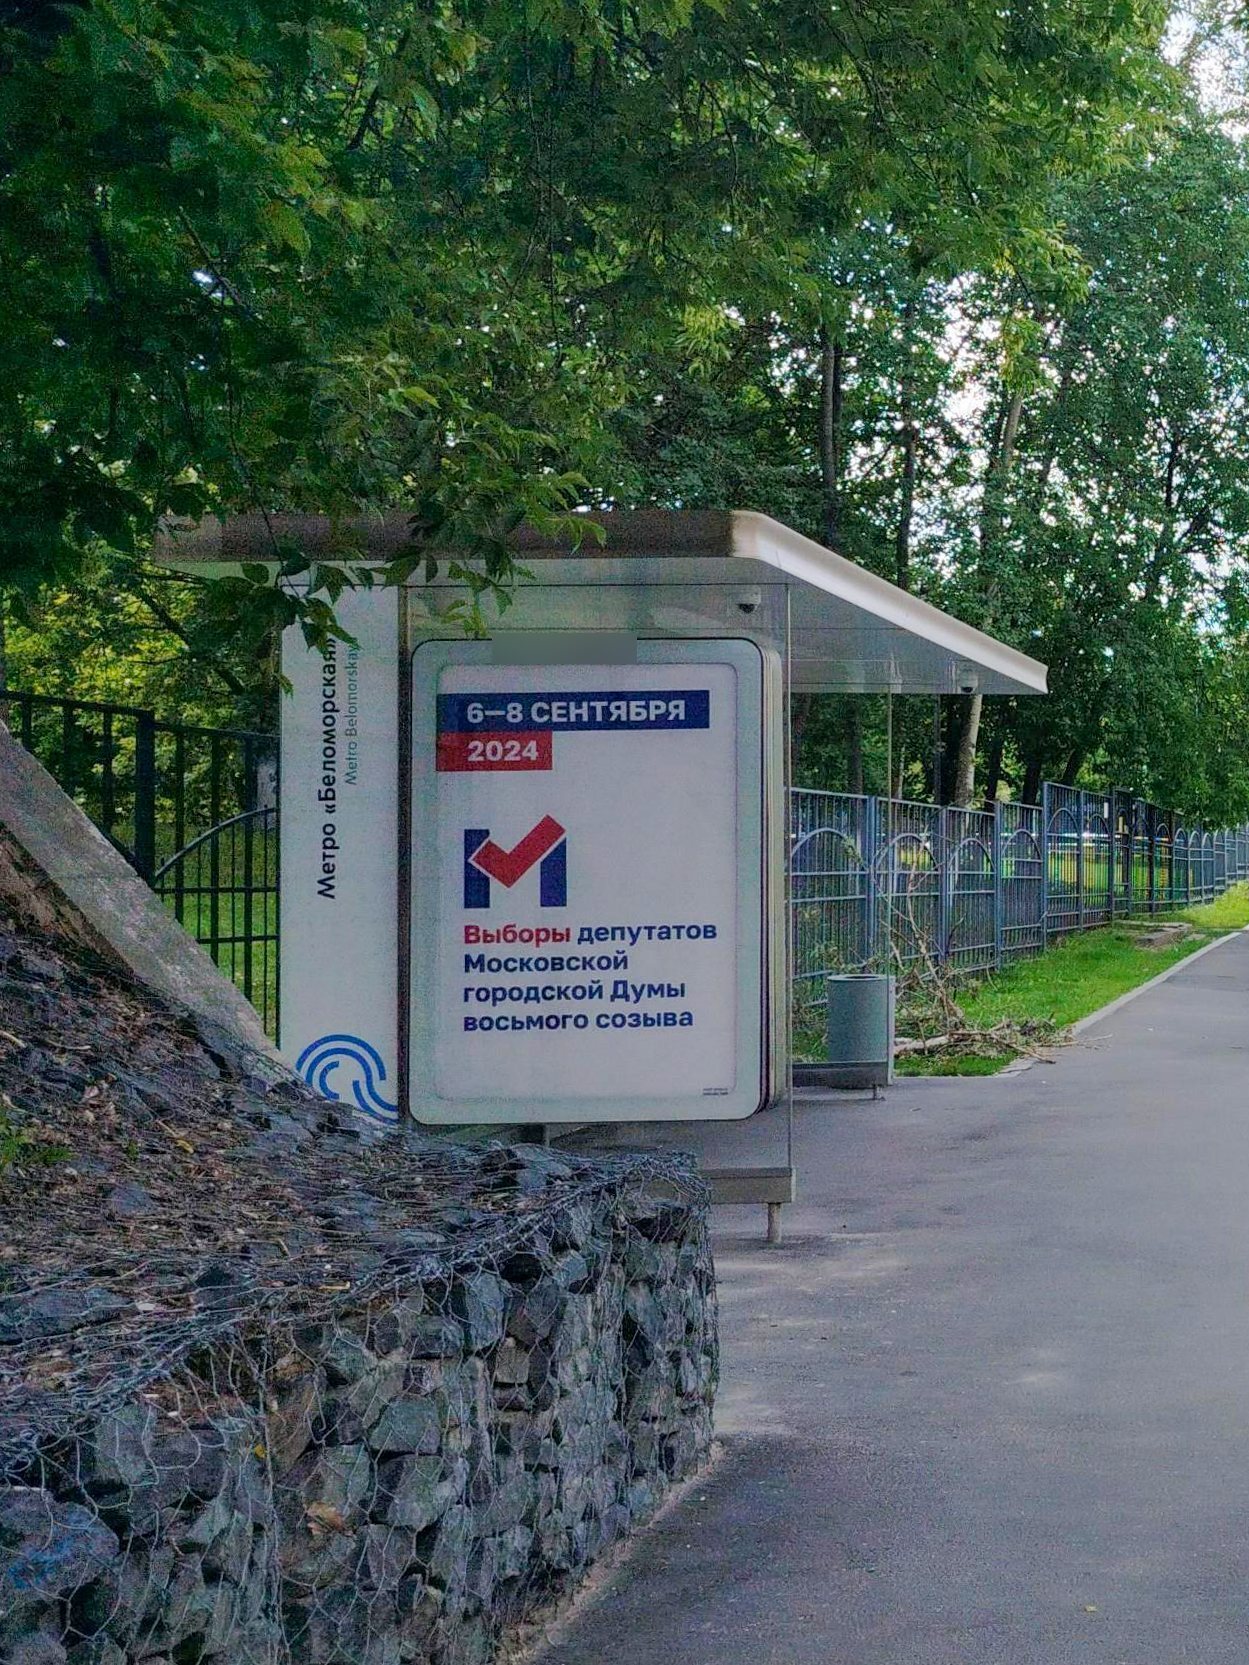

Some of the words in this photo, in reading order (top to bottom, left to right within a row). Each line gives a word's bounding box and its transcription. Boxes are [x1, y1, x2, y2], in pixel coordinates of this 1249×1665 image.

[530, 700, 686, 723] СЕНТЯБРЯ
[318, 638, 340, 814] «Беломорская»
[467, 739, 539, 762] 2024
[344, 741, 358, 786] Metro
[317, 823, 340, 899] Метро
[463, 923, 571, 948] Выборы
[577, 924, 718, 947] депутатов
[463, 950, 629, 973] Московской
[463, 979, 604, 1008] городской
[610, 980, 686, 1004] Думы
[463, 1013, 589, 1032] восьмого
[595, 1010, 694, 1029] созыва
